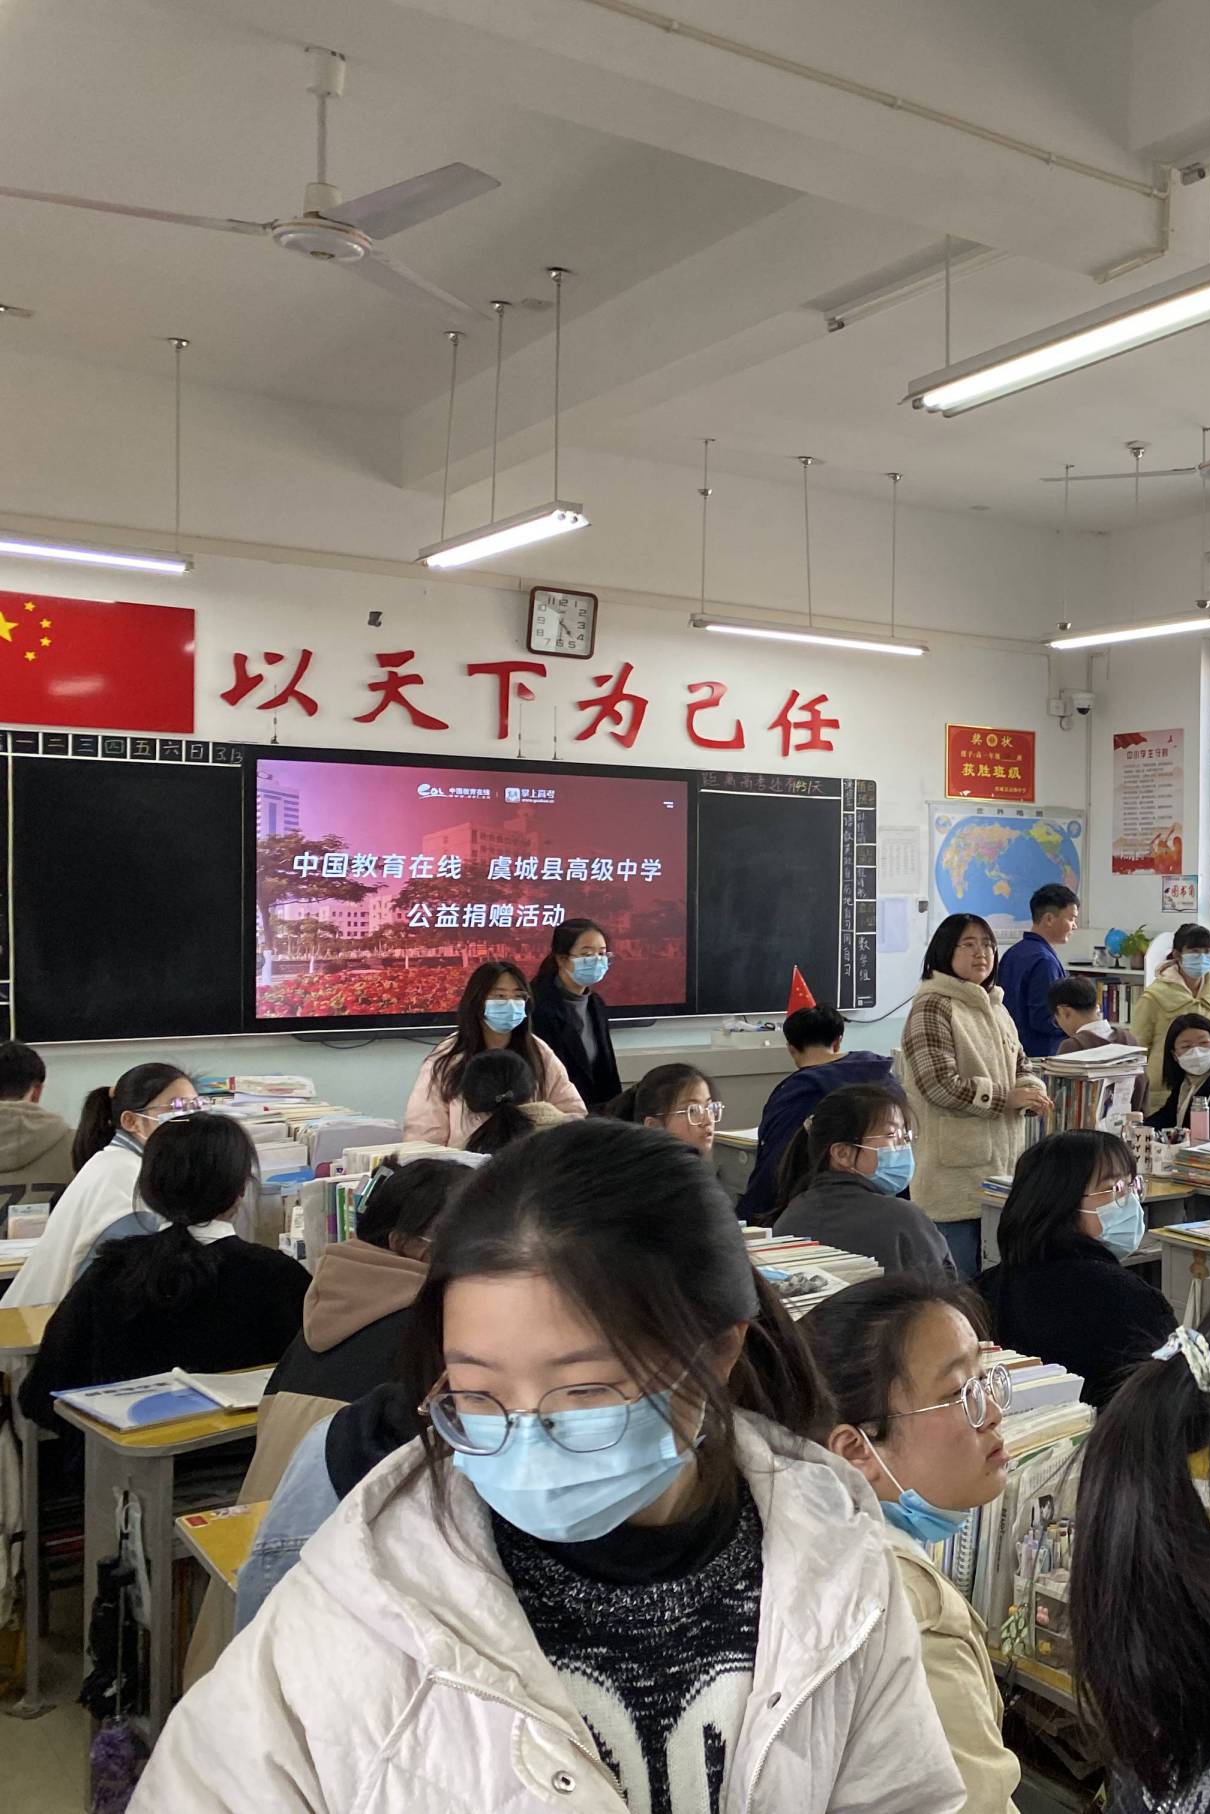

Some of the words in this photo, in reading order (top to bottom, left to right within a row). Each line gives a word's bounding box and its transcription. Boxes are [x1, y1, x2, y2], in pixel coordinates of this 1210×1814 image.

[220, 648, 841, 757] 以天下为己任
[961, 763, 1022, 779] 获胜班级
[292, 851, 462, 880] 中国教育在线
[487, 856, 662, 882] 虞城县高级中学
[406, 903, 566, 929] 公益捐赠活动
